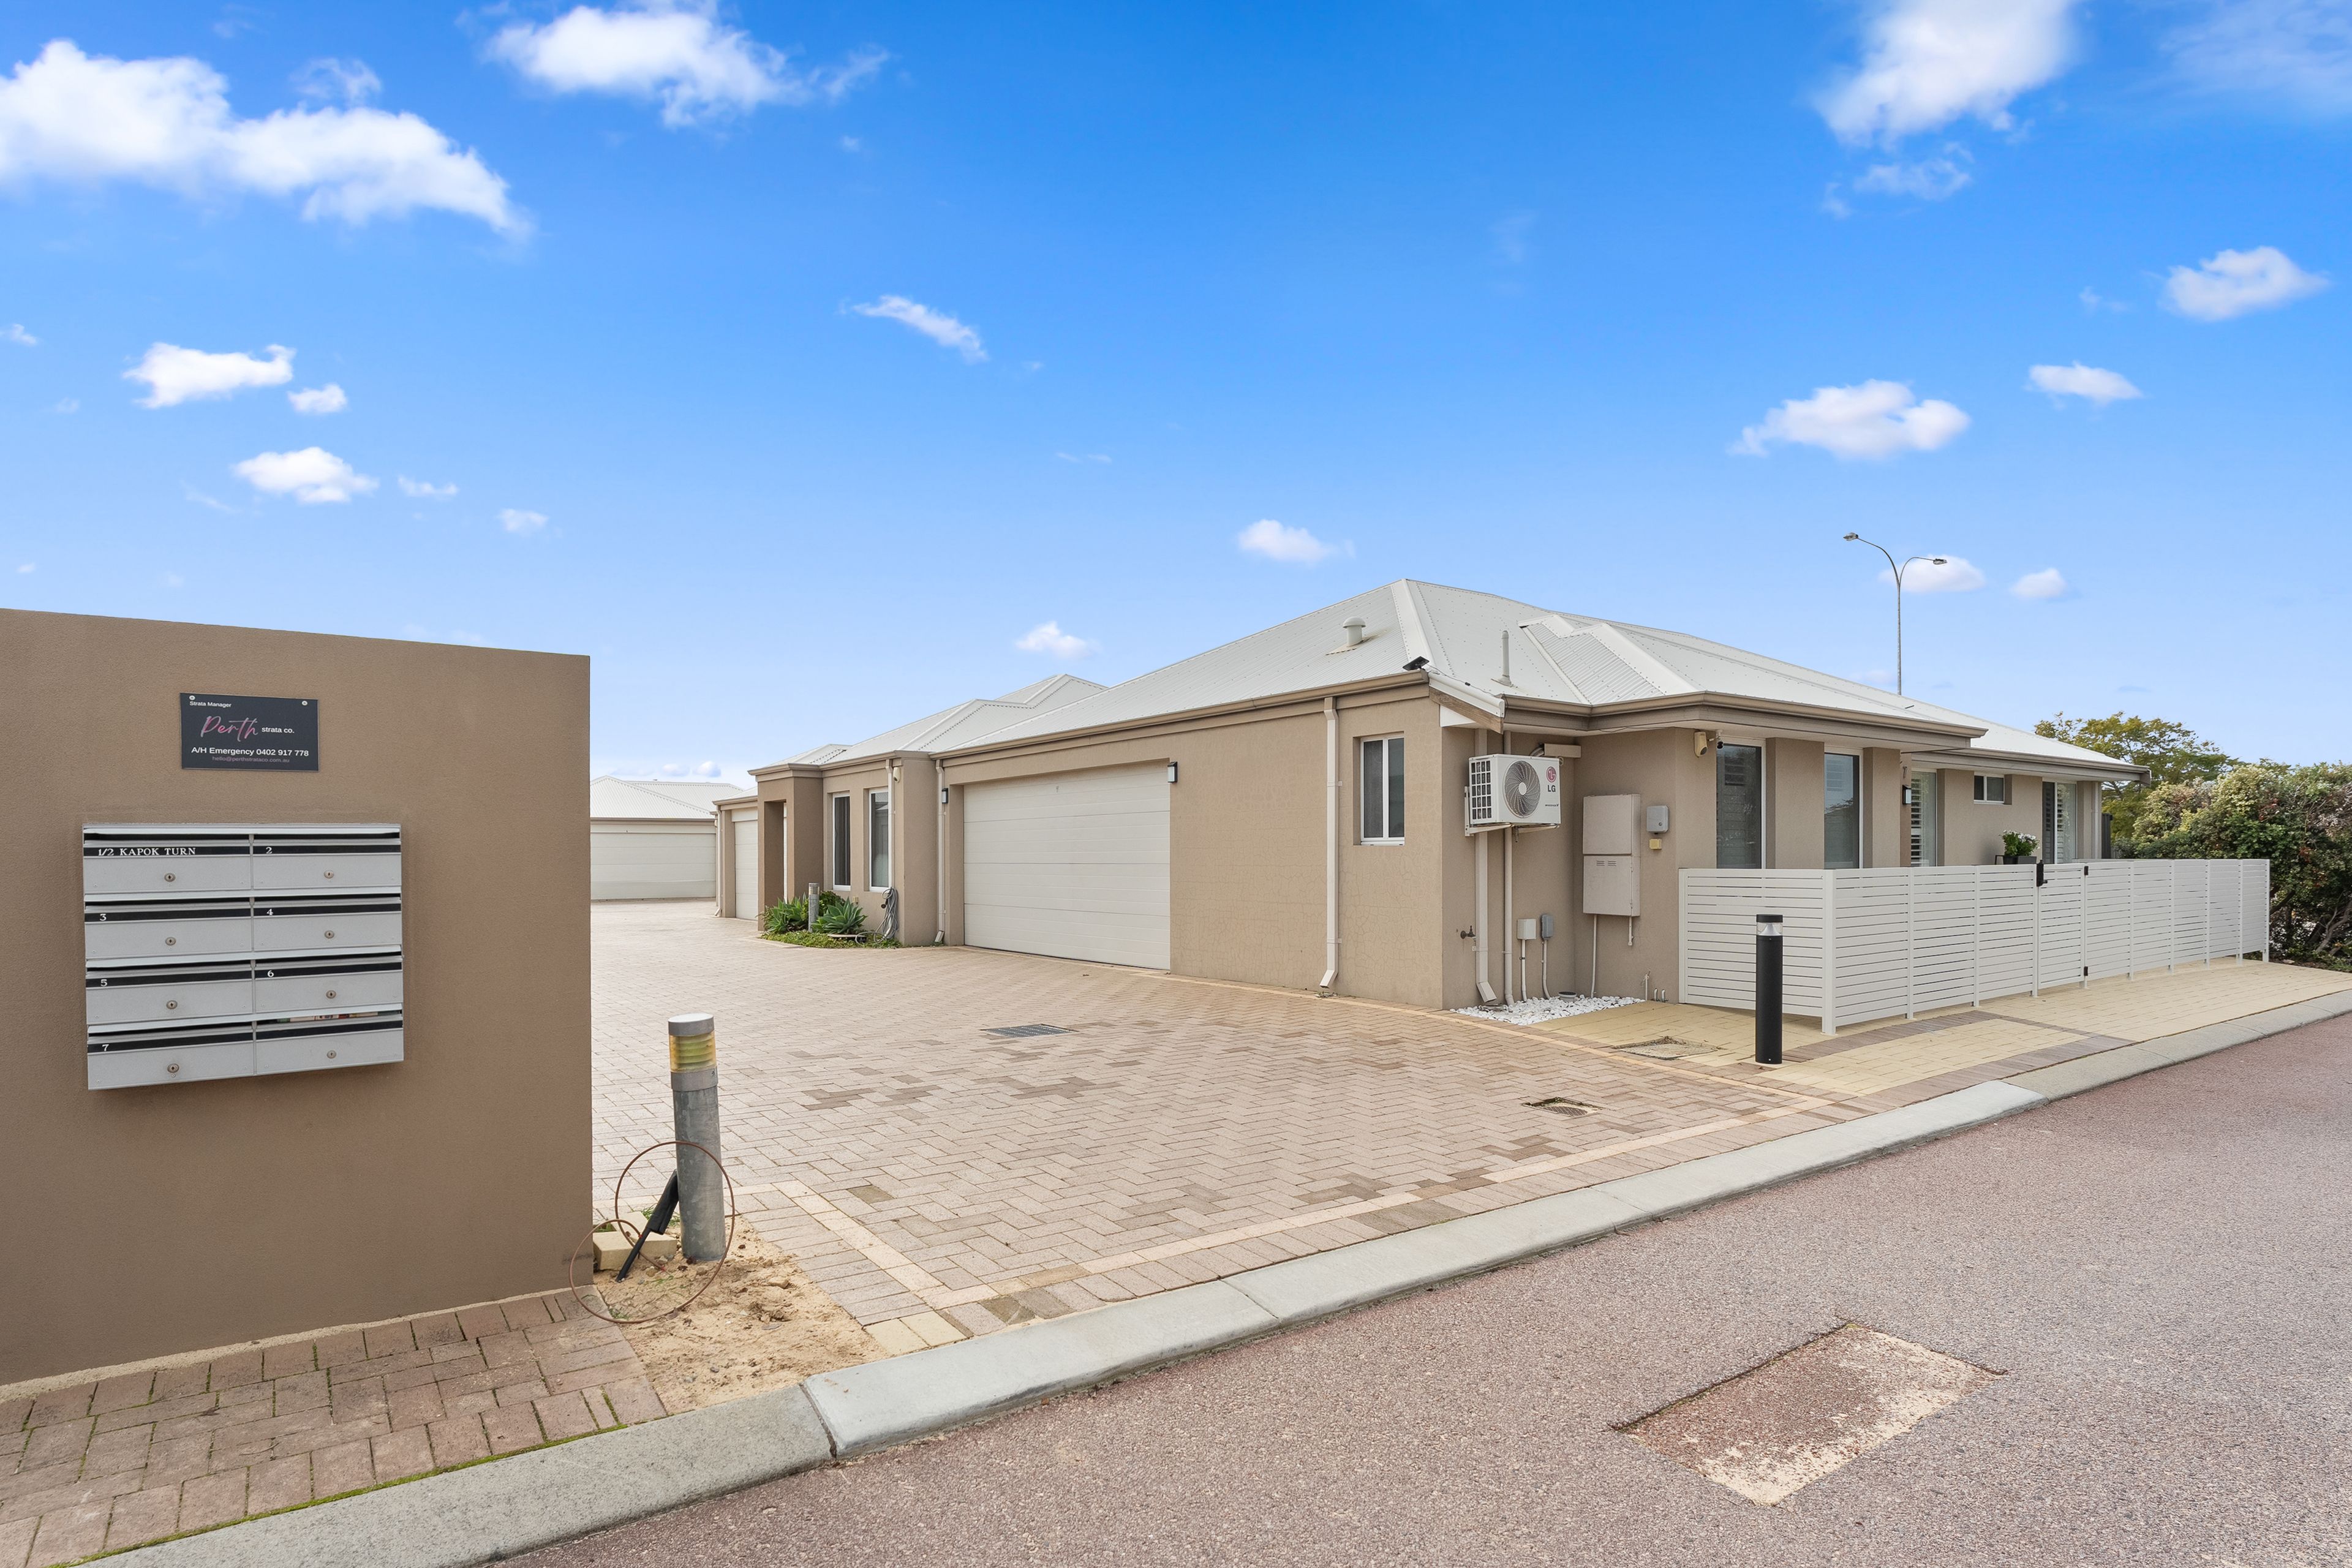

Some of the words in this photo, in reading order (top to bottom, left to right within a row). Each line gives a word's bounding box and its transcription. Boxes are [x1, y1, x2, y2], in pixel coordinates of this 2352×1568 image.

[200, 715, 258, 742] Perth
[209, 747, 254, 756] Emergency
[98, 848, 115, 856] 1/2
[164, 847, 196, 856] TURN
